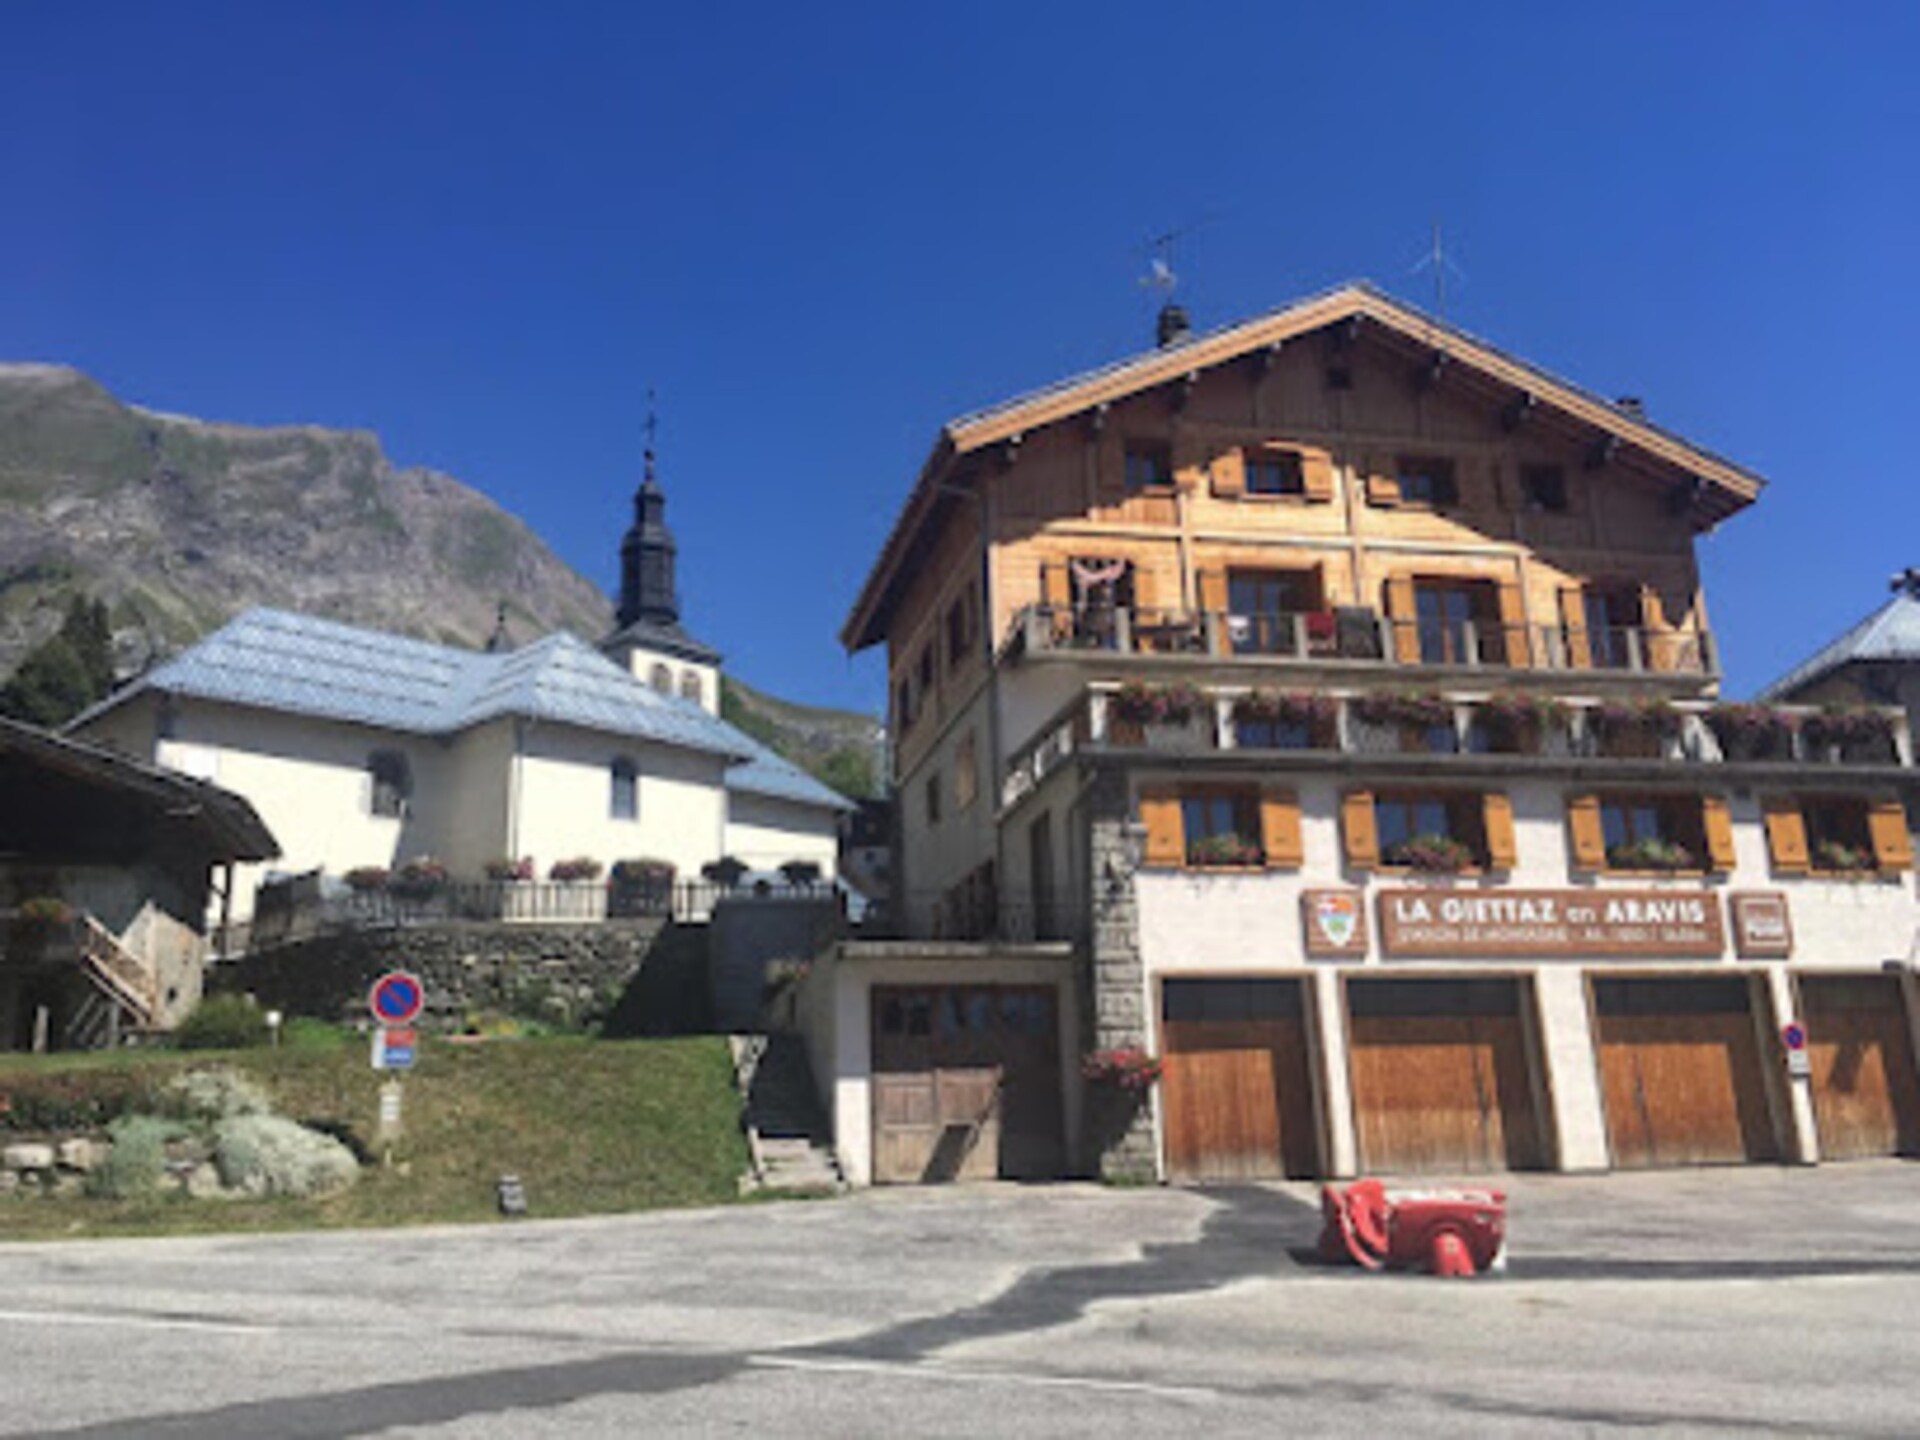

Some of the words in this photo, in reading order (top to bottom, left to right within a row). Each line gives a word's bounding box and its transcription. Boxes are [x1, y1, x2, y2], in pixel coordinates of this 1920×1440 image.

[1396, 899, 1431, 923] LA
[1566, 907, 1597, 923] en
[1604, 899, 1706, 923] ARAVIS
